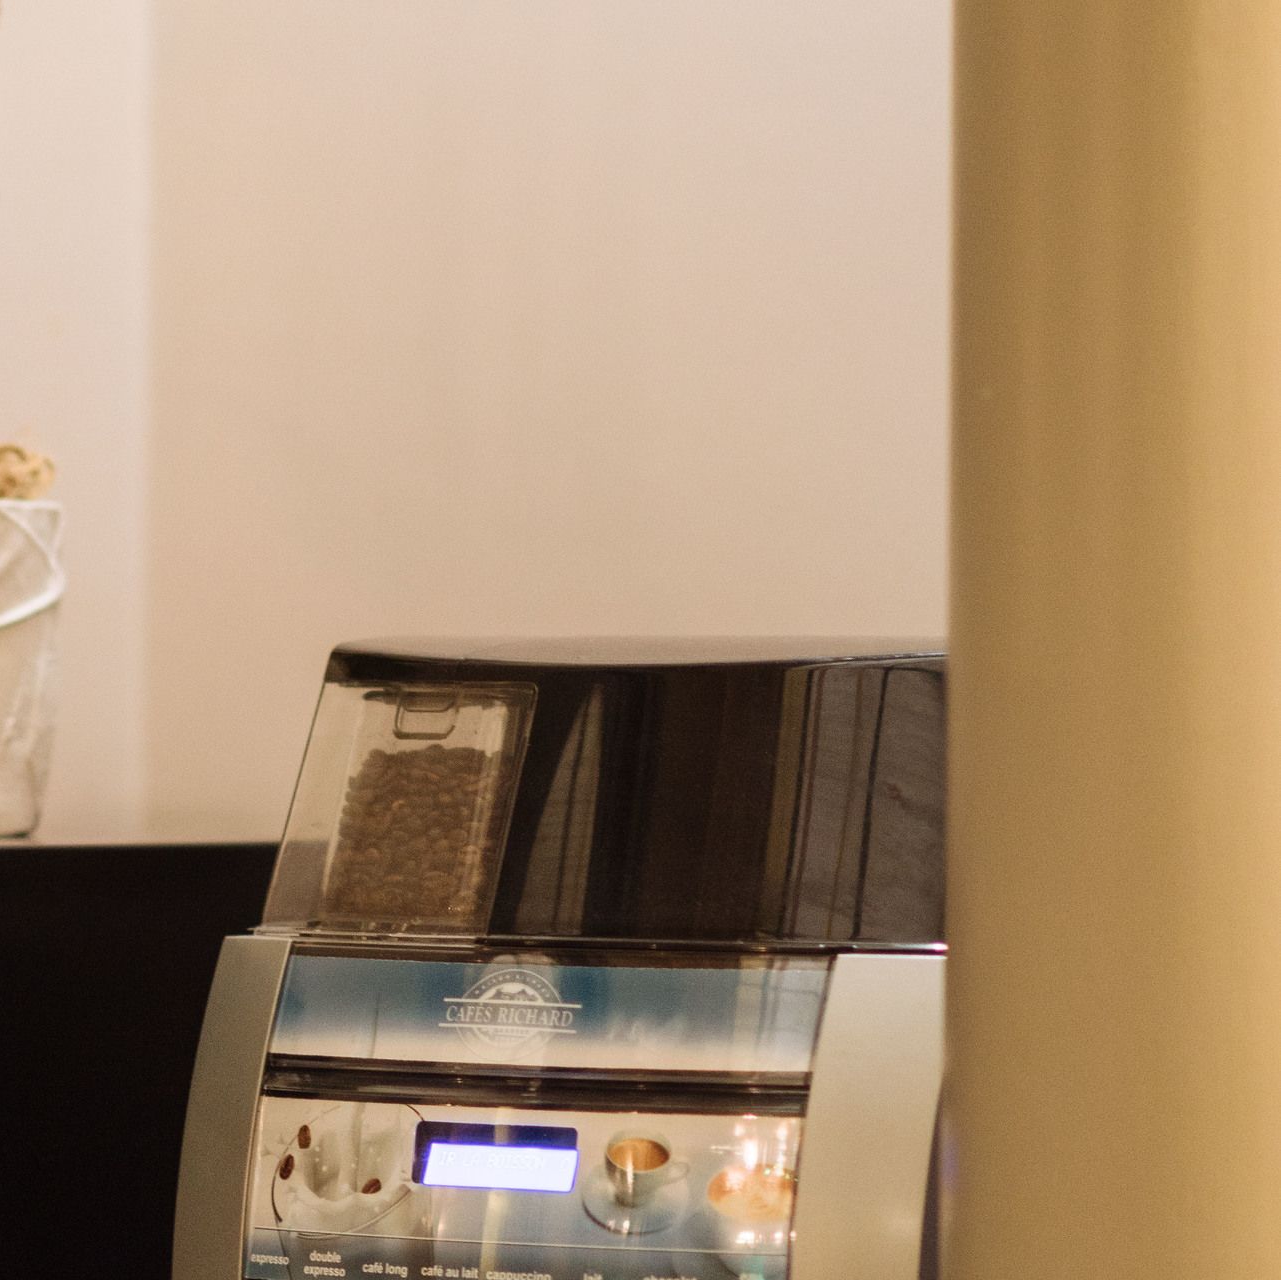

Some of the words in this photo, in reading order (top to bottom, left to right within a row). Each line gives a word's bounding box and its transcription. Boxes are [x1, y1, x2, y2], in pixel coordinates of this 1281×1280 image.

[445, 1003, 493, 1023] CAFÉS
[497, 1006, 573, 1027] RICHARD
[250, 1253, 290, 1266] expresso
[309, 1250, 342, 1263] double
[303, 1264, 346, 1278] expresso
[362, 1262, 384, 1274] café
[385, 1263, 408, 1278] long
[421, 1265, 444, 1277] café
[445, 1268, 460, 1278] au
[461, 1267, 480, 1279] lait
